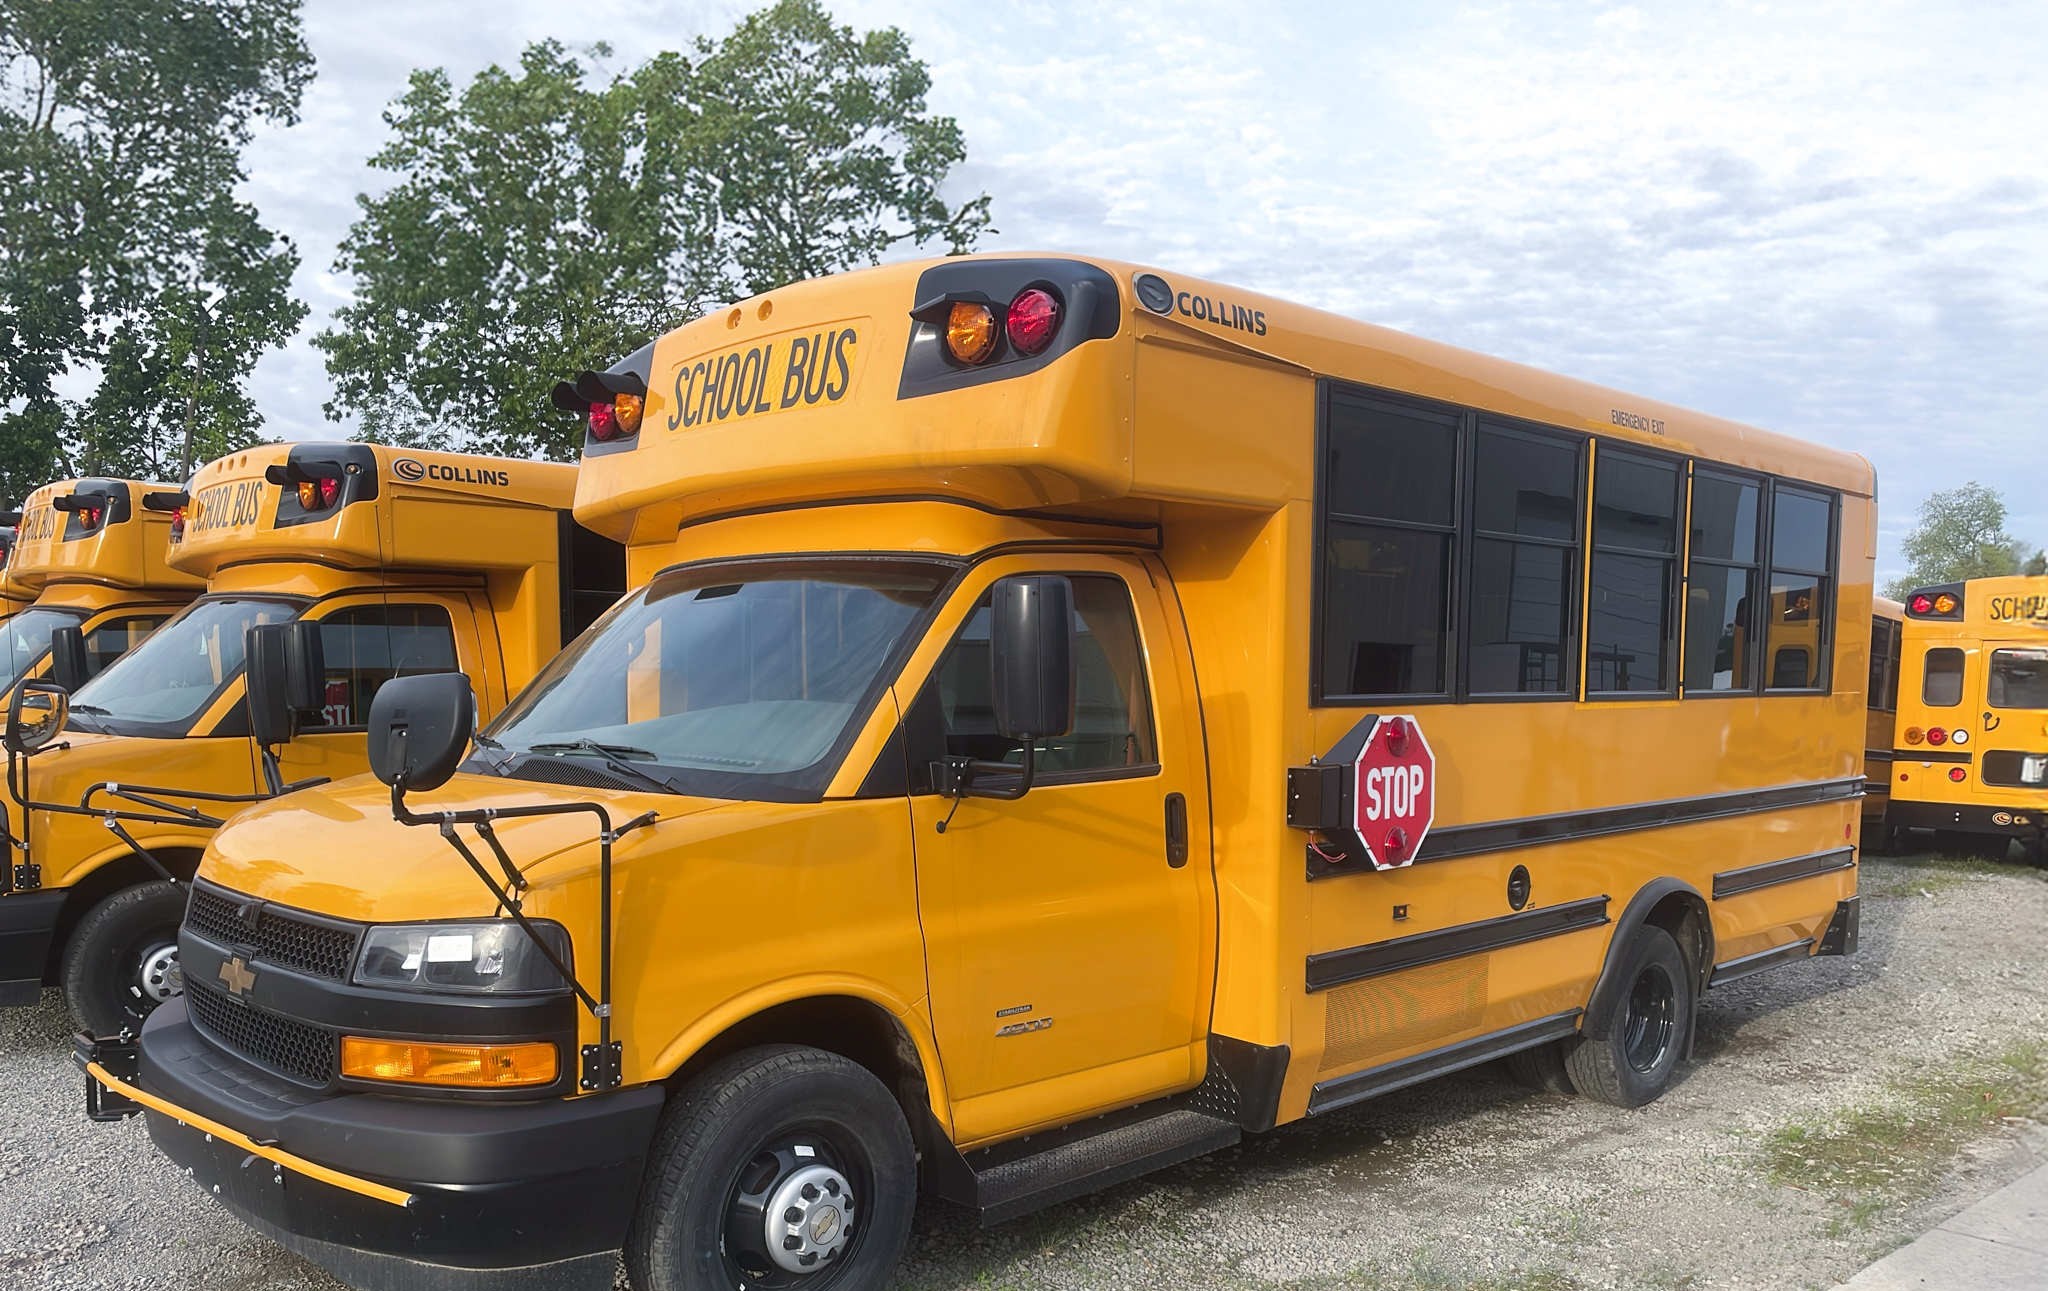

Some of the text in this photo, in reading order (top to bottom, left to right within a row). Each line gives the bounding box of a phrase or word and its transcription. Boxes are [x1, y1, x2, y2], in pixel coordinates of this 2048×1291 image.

[1177, 291, 1267, 336] COLLINS
[667, 328, 857, 431] SCHOOL BUS
[1611, 409, 1665, 435] EMERGENCY EXIT
[428, 464, 509, 487] COLLINS
[231, 480, 263, 526] BUS
[1366, 764, 1425, 821] STOP
